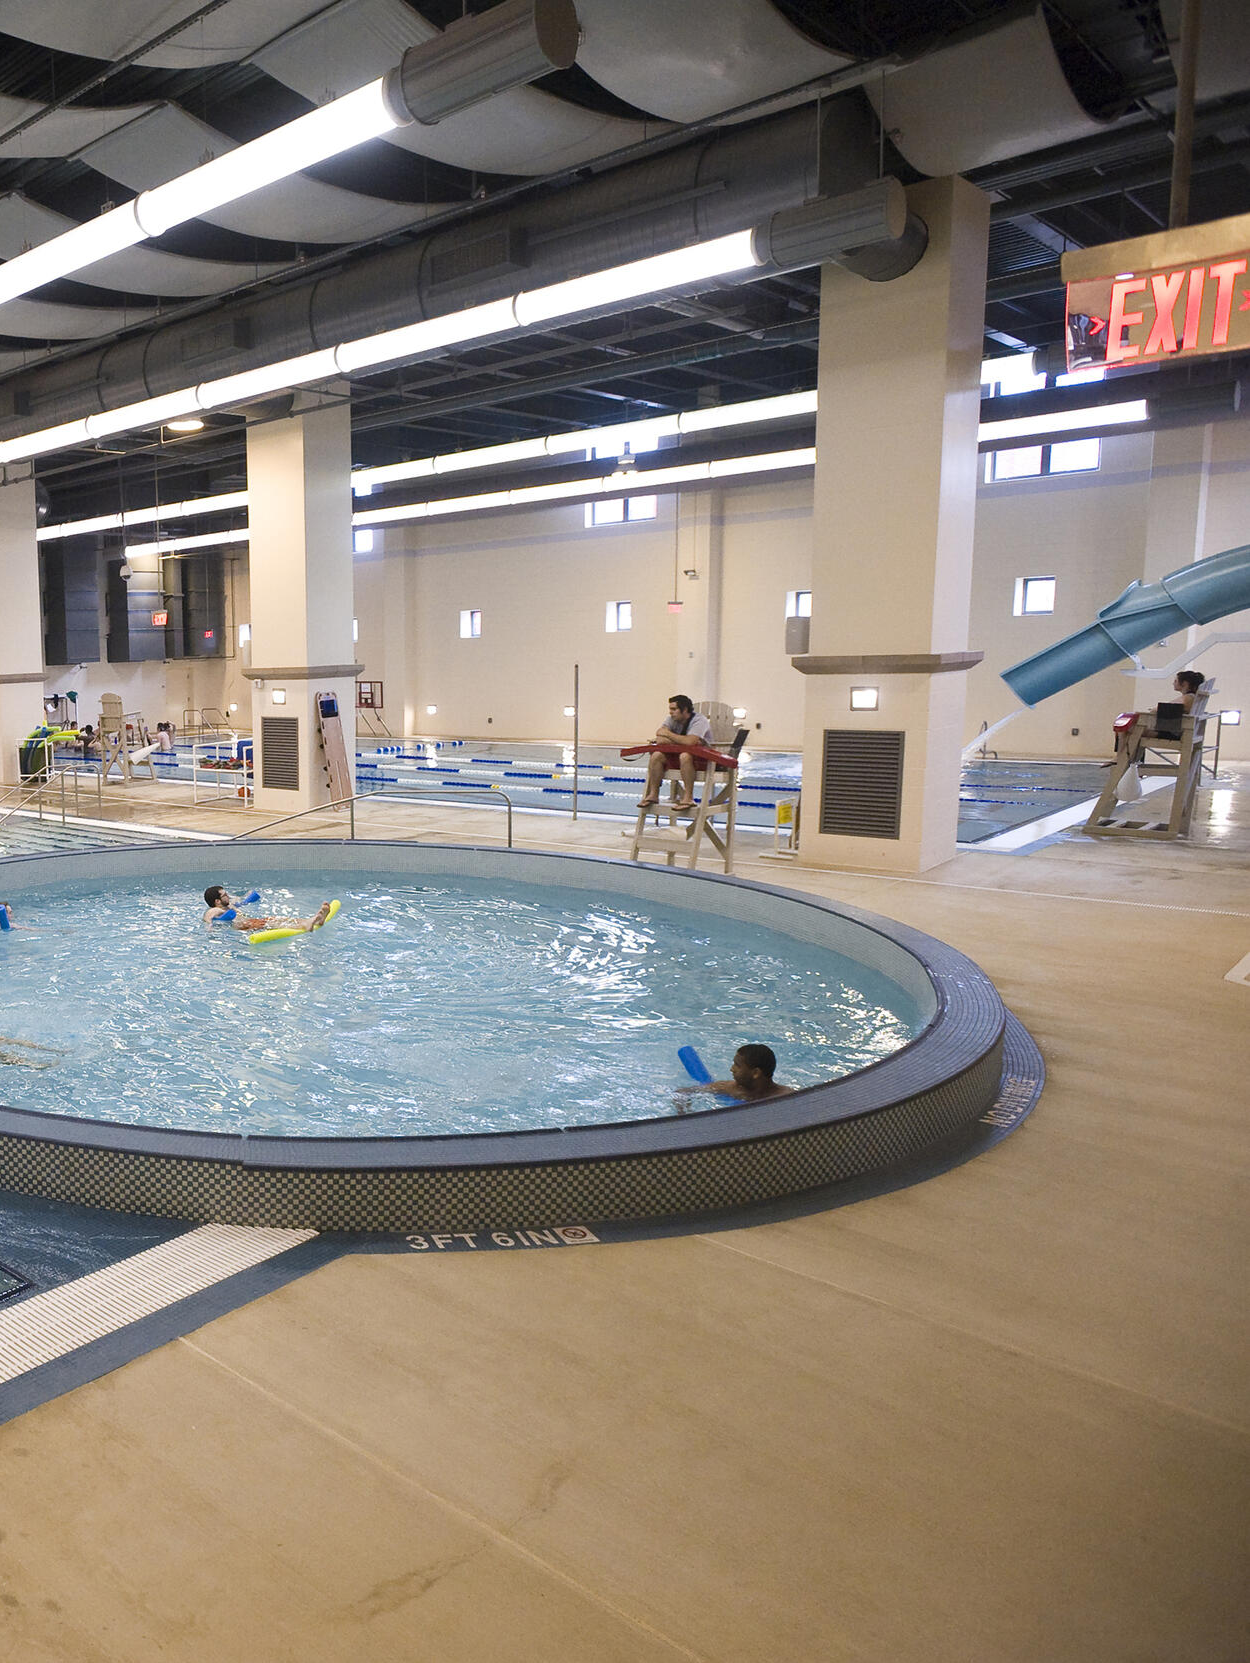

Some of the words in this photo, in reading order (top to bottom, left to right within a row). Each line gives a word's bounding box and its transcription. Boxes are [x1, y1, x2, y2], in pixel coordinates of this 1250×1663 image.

[1105, 259, 1247, 361] EXIT
[406, 1233, 478, 1250] 3FT
[491, 1229, 559, 1247] 6IN
